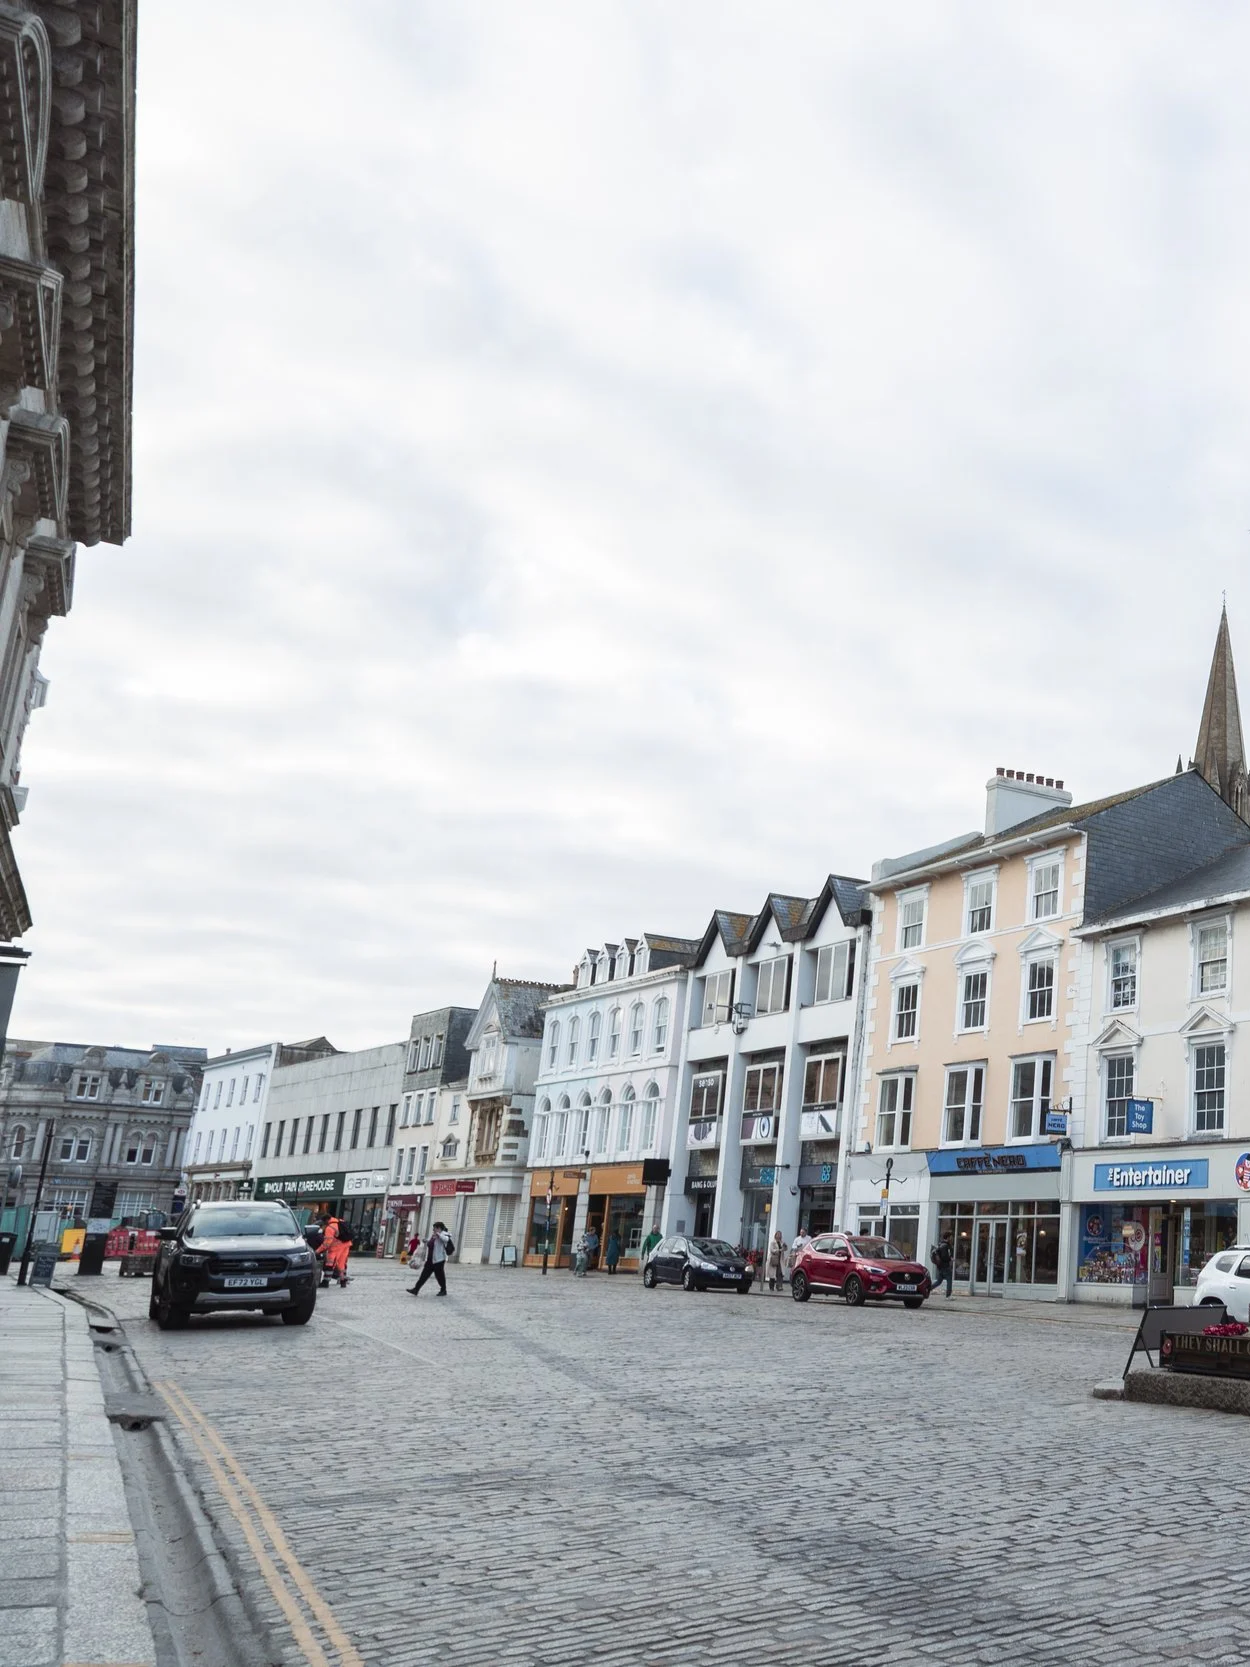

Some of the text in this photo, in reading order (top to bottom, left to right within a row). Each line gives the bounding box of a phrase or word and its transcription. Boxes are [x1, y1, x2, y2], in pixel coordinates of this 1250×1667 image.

[1135, 1113, 1145, 1122] Toy
[1132, 1121, 1147, 1130] Shop
[956, 1152, 1026, 1169] CAFFÈ NERO
[1113, 1165, 1191, 1187] Entertainer
[691, 1180, 703, 1189] BANG
[1174, 1335, 1202, 1350] THEY
[1205, 1338, 1245, 1355] SHALL
